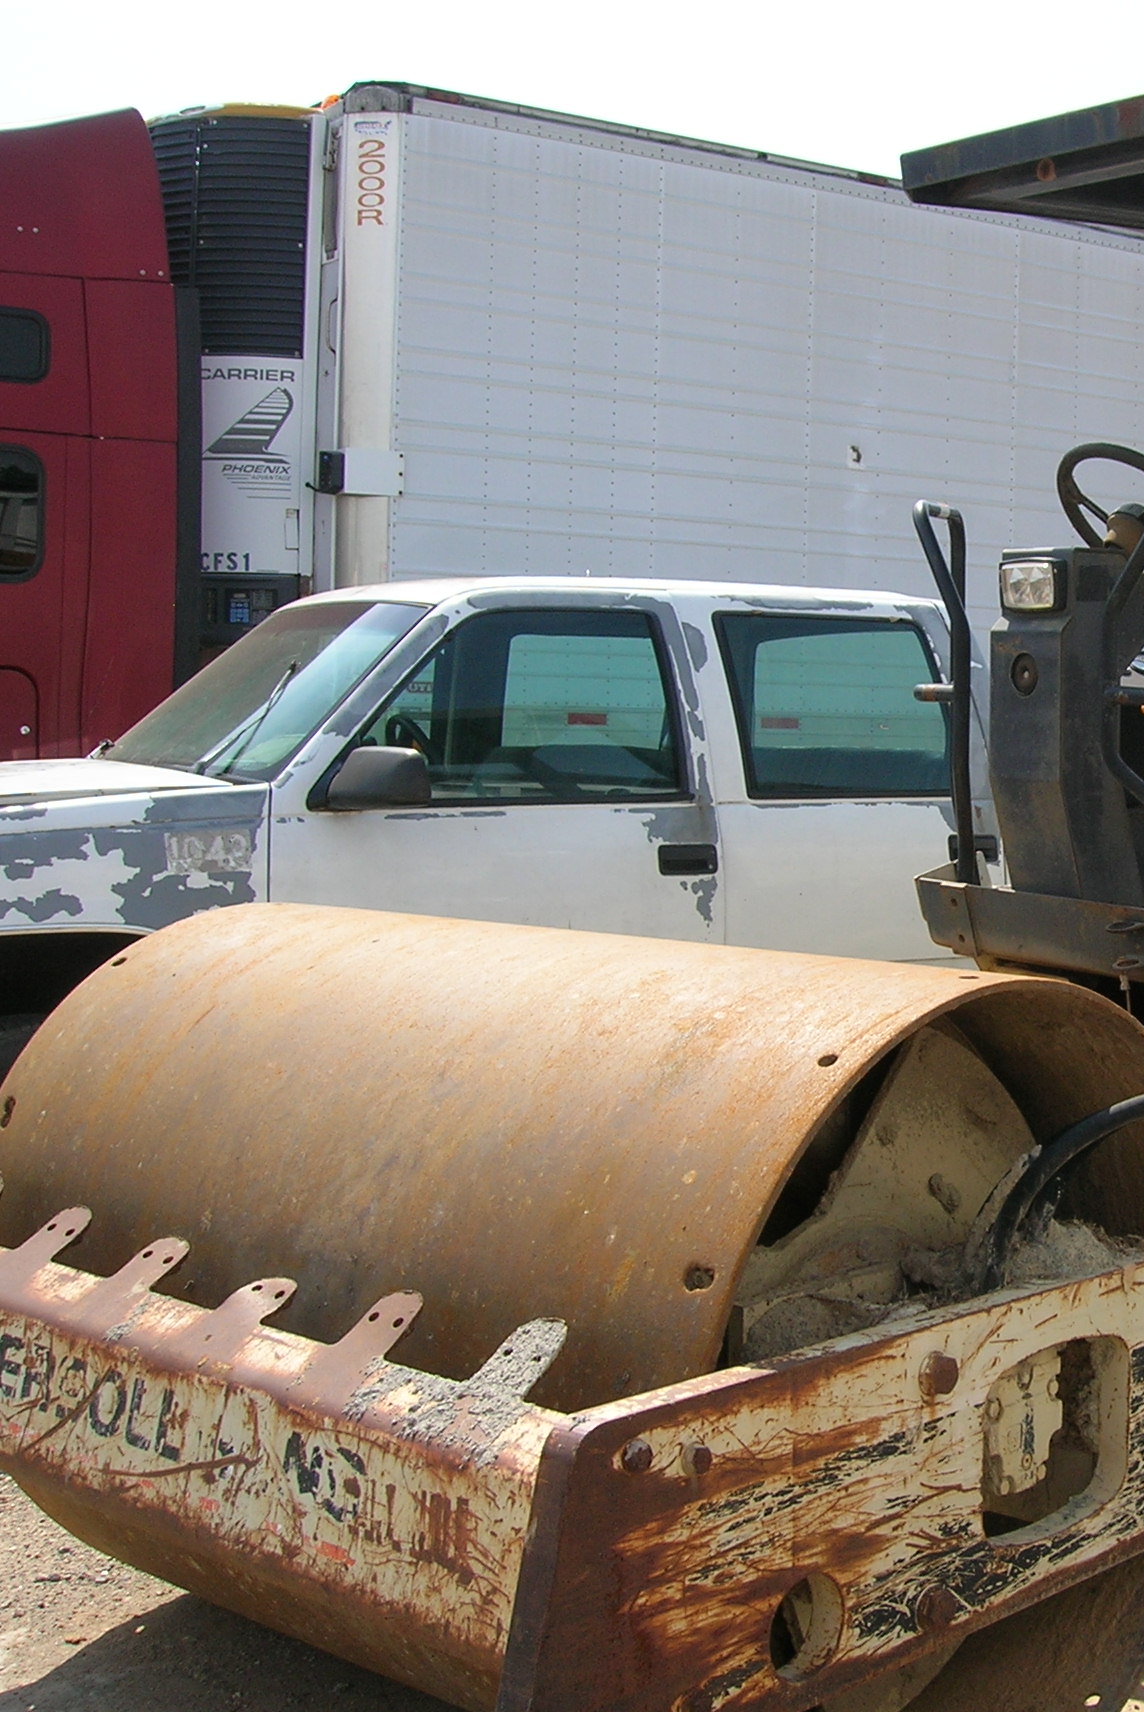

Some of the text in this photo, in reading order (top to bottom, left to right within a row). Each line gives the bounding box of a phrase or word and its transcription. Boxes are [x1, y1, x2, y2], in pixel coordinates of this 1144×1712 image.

[357, 139, 385, 226] 2000R
[201, 367, 295, 382] CARRIER
[221, 464, 291, 474] PHOENIX
